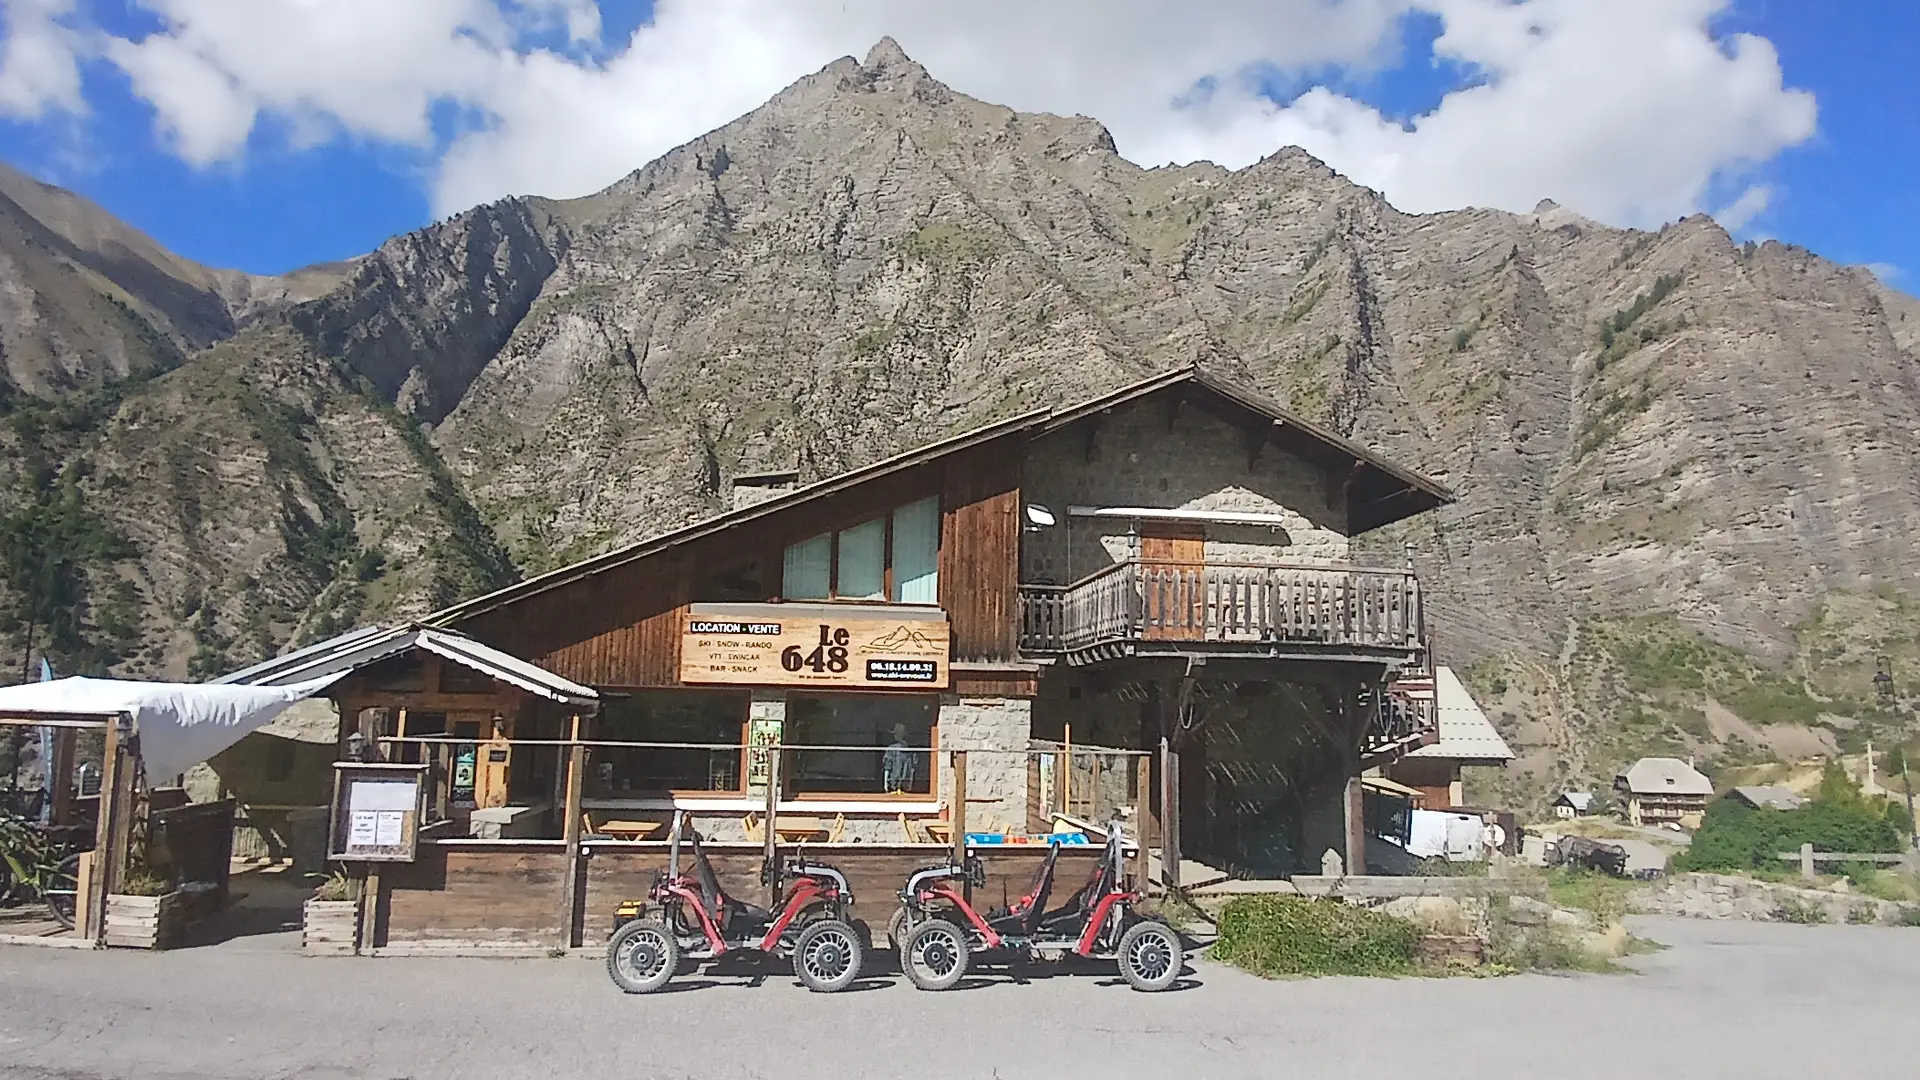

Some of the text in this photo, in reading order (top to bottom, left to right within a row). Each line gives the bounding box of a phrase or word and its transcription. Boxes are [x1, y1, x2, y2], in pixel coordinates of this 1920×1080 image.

[692, 622, 780, 634] LOCATION VENTE
[818, 624, 850, 646] Le
[698, 640, 773, 649] SKI SNOW RANDO
[781, 645, 849, 673] 648
[732, 665, 758, 673] SNACK
